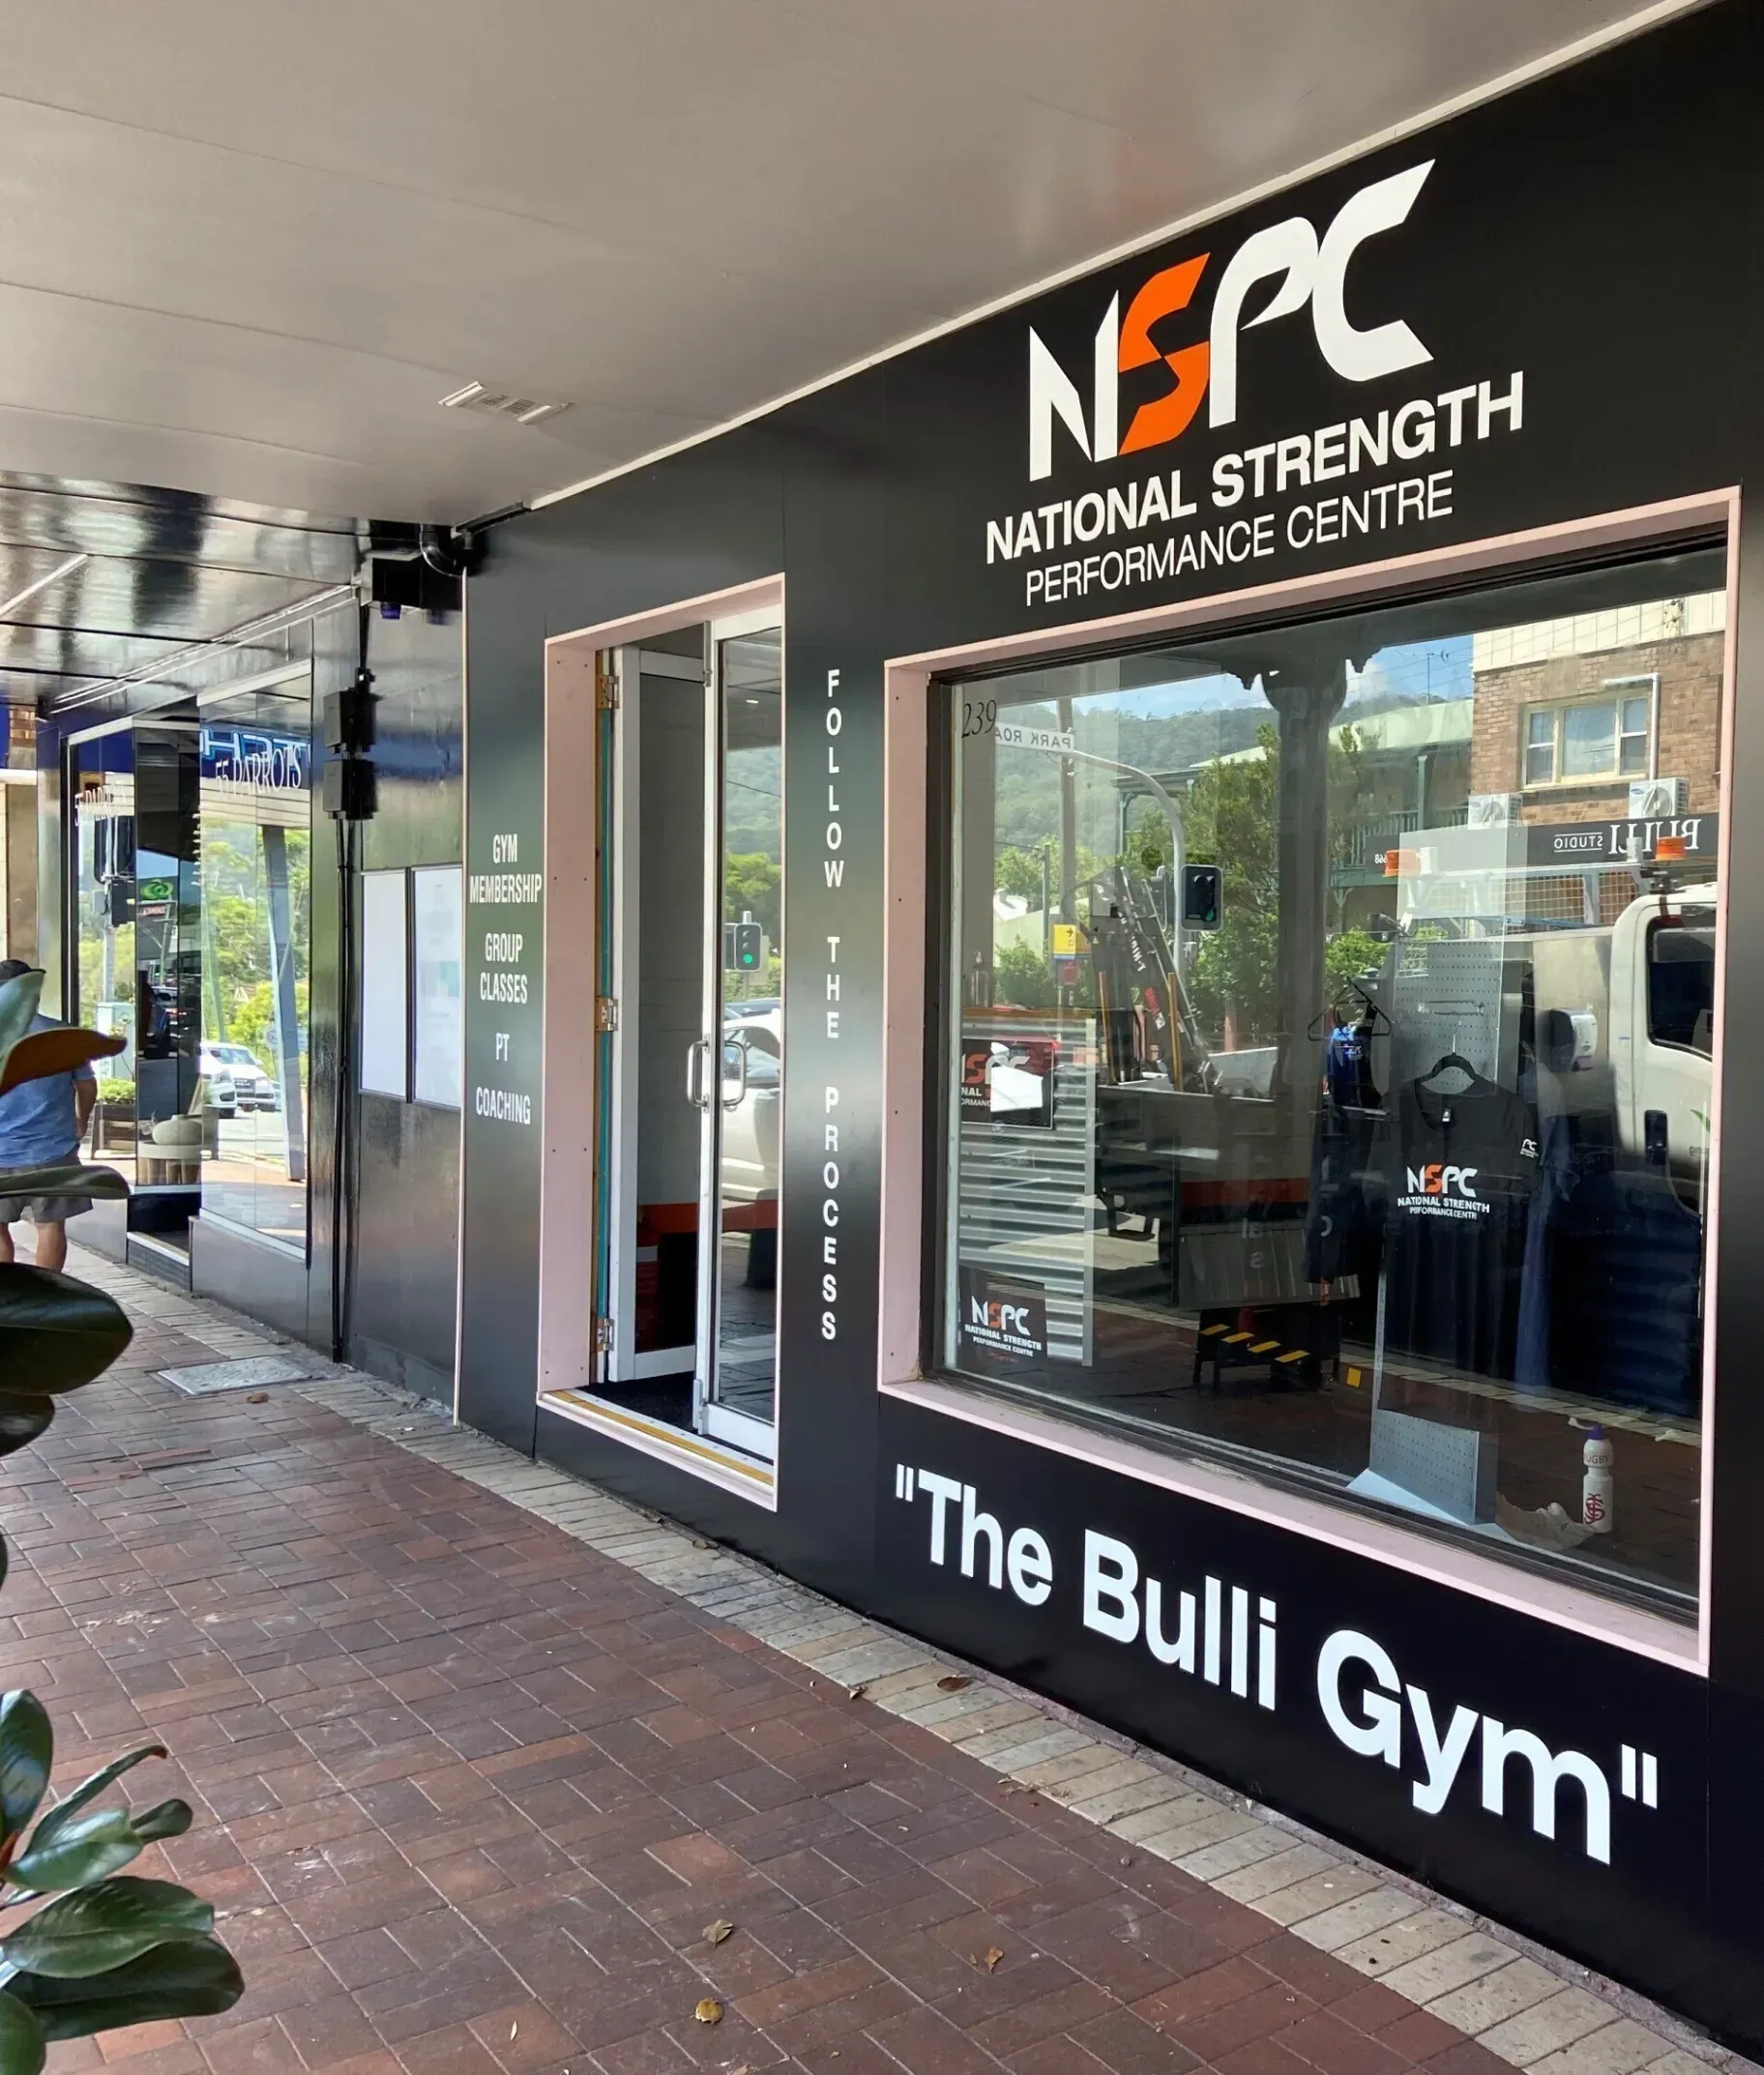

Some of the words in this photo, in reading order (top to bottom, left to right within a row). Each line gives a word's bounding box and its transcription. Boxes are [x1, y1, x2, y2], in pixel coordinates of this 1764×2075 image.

[1029, 159, 1435, 482] NSPC
[986, 471, 1197, 565] NATIONAL
[1212, 370, 1523, 508] STRENGTH
[1026, 514, 1275, 606] PERFORMANCE
[1286, 469, 1454, 550] CENTRE
[961, 700, 996, 738] 239
[233, 744, 302, 798] PARROTS
[824, 669, 844, 888] FOLLOW
[492, 833, 517, 863] GYM
[469, 873, 543, 904] MEMBERSHIP
[485, 933, 523, 962] GROUP
[480, 972, 528, 1005] CLASSES
[826, 936, 840, 1038] THE
[495, 1032, 510, 1062] PT
[475, 1086, 531, 1125] COACHING
[1407, 1164, 1478, 1198] NSPC
[821, 1086, 839, 1341] PROCESS
[1396, 1196, 1441, 1207] NATIONAL
[1443, 1197, 1490, 1213] STRENGTH
[971, 1295, 1031, 1336] NSPC
[964, 1324, 1001, 1340] NATIONAL
[1003, 1333, 1042, 1351] STRENGTH
[1082, 1528, 1277, 1710] Bulli
